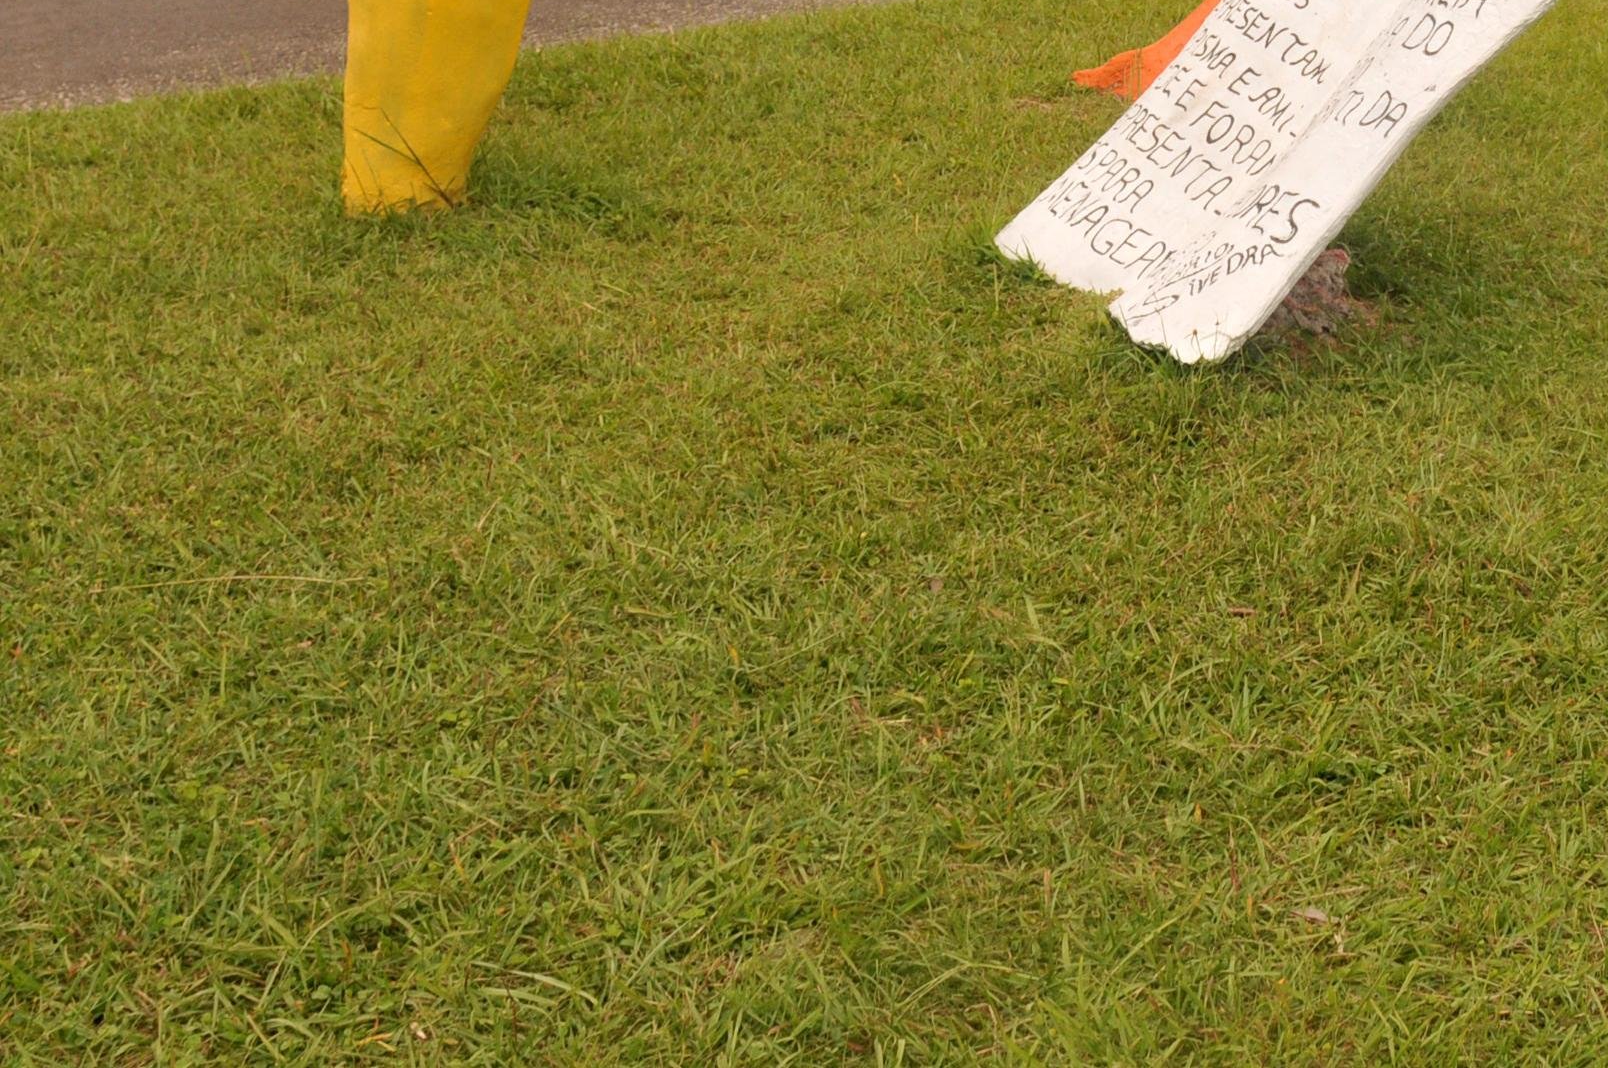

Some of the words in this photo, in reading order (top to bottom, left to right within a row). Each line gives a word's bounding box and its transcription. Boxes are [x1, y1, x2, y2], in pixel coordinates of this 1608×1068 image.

[1401, 12, 1455, 56] DO
[1174, 78, 1208, 112] E
[1227, 66, 1262, 96] E
[1084, 148, 1154, 214] PARA
